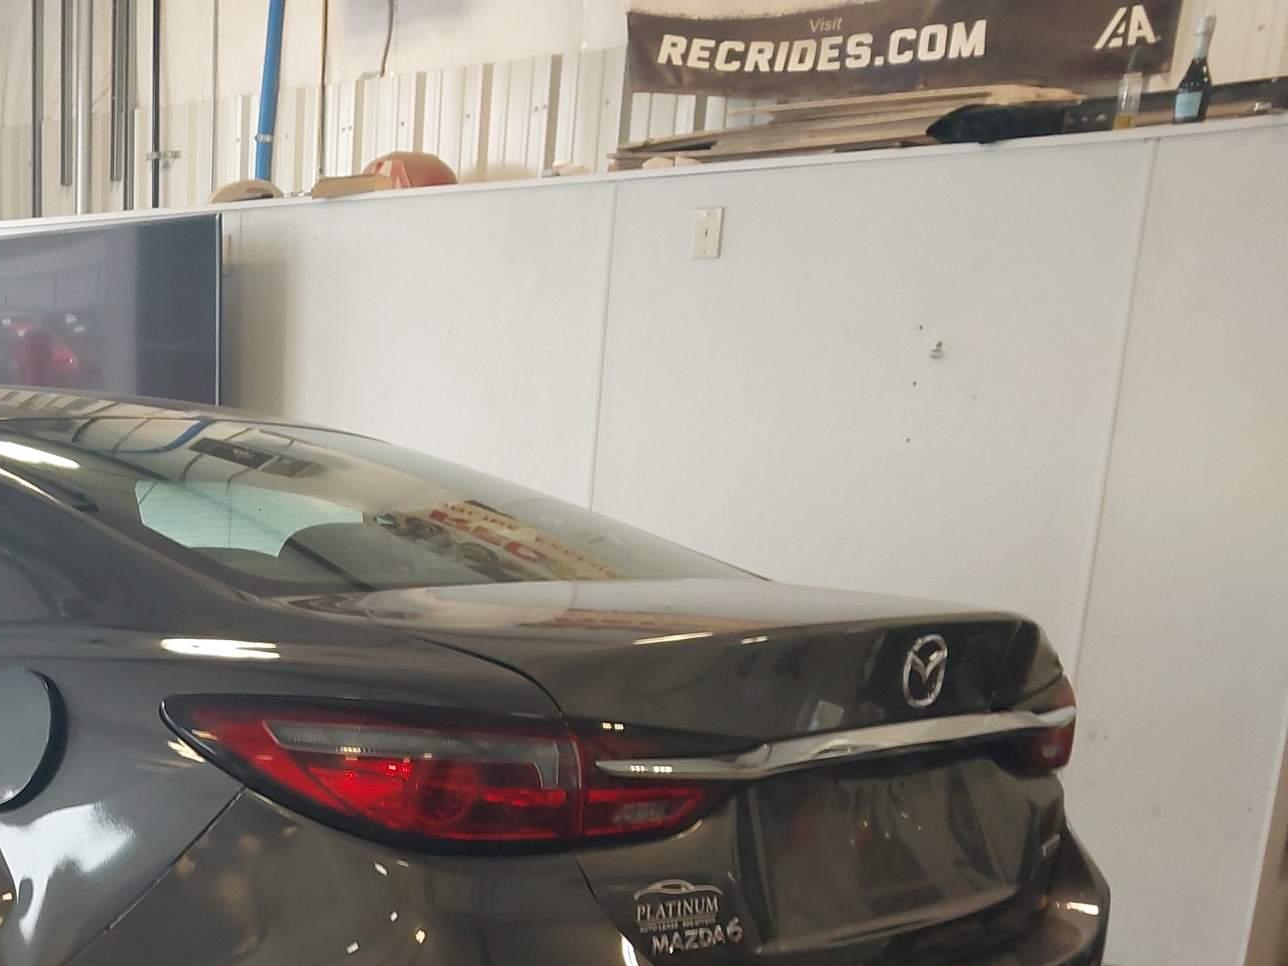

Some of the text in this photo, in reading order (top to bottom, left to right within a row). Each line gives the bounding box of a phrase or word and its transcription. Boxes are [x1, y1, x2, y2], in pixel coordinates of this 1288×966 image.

[809, 17, 843, 33] Visit
[657, 19, 987, 72] RECRIDES.COM
[636, 896, 719, 921] PLATINUM
